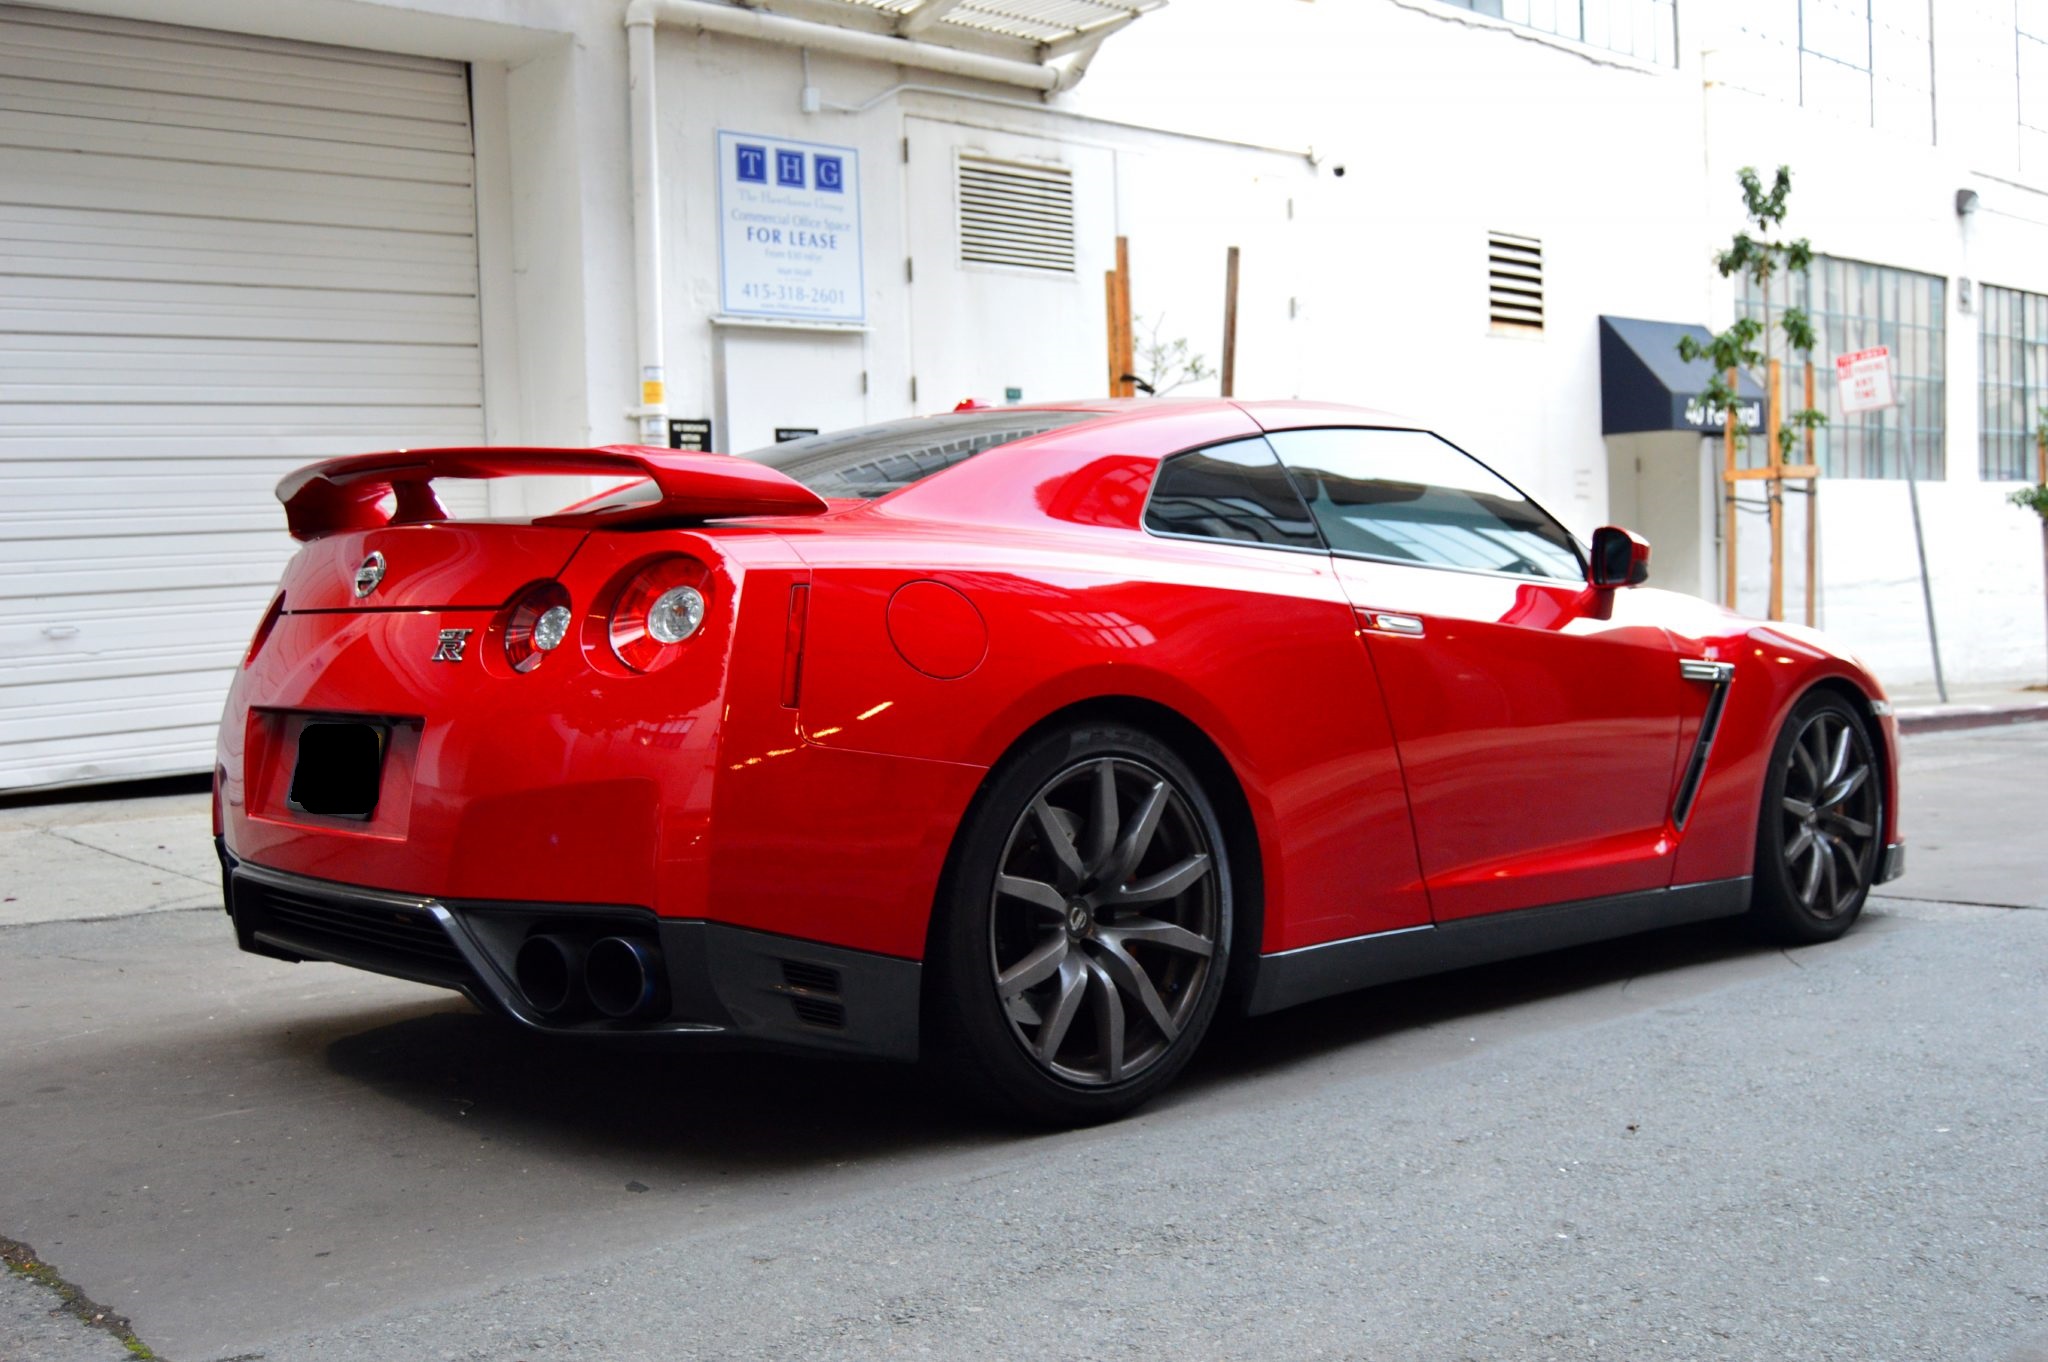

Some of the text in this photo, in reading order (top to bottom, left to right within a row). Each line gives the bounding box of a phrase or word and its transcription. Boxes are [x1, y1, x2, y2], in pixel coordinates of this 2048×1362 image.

[731, 208, 790, 226] Commercial
[792, 214, 821, 229] Office
[746, 227, 838, 250] FOR LEASE
[742, 283, 845, 305] 415-318-2601
